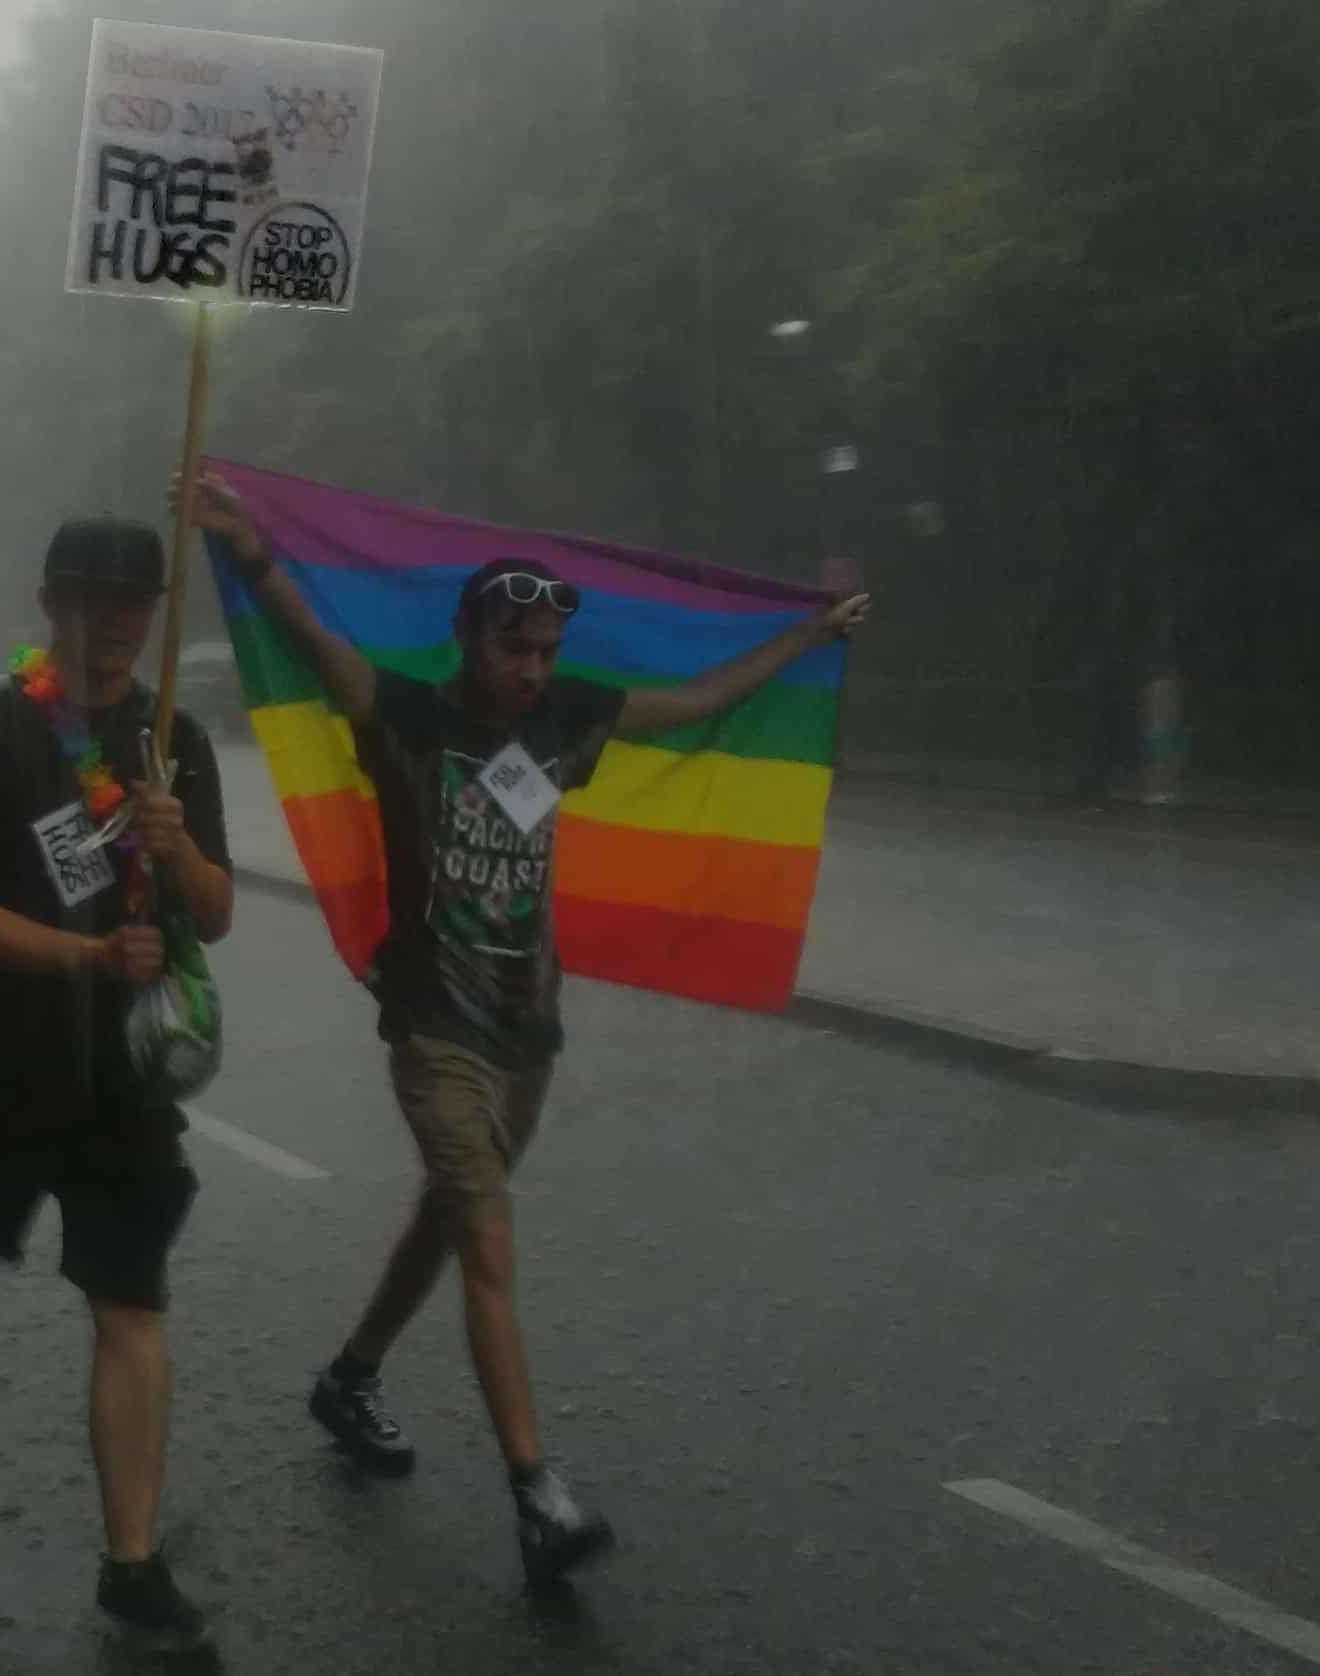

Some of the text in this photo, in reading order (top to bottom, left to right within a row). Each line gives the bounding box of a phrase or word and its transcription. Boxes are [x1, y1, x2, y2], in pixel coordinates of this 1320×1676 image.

[100, 95, 172, 131] CSD
[98, 145, 237, 232] FREE
[265, 222, 333, 249] STOP
[89, 220, 231, 288] HUGS
[254, 247, 337, 278] HOMO
[250, 274, 333, 302] PHOBIA
[445, 849, 546, 892] COAST
